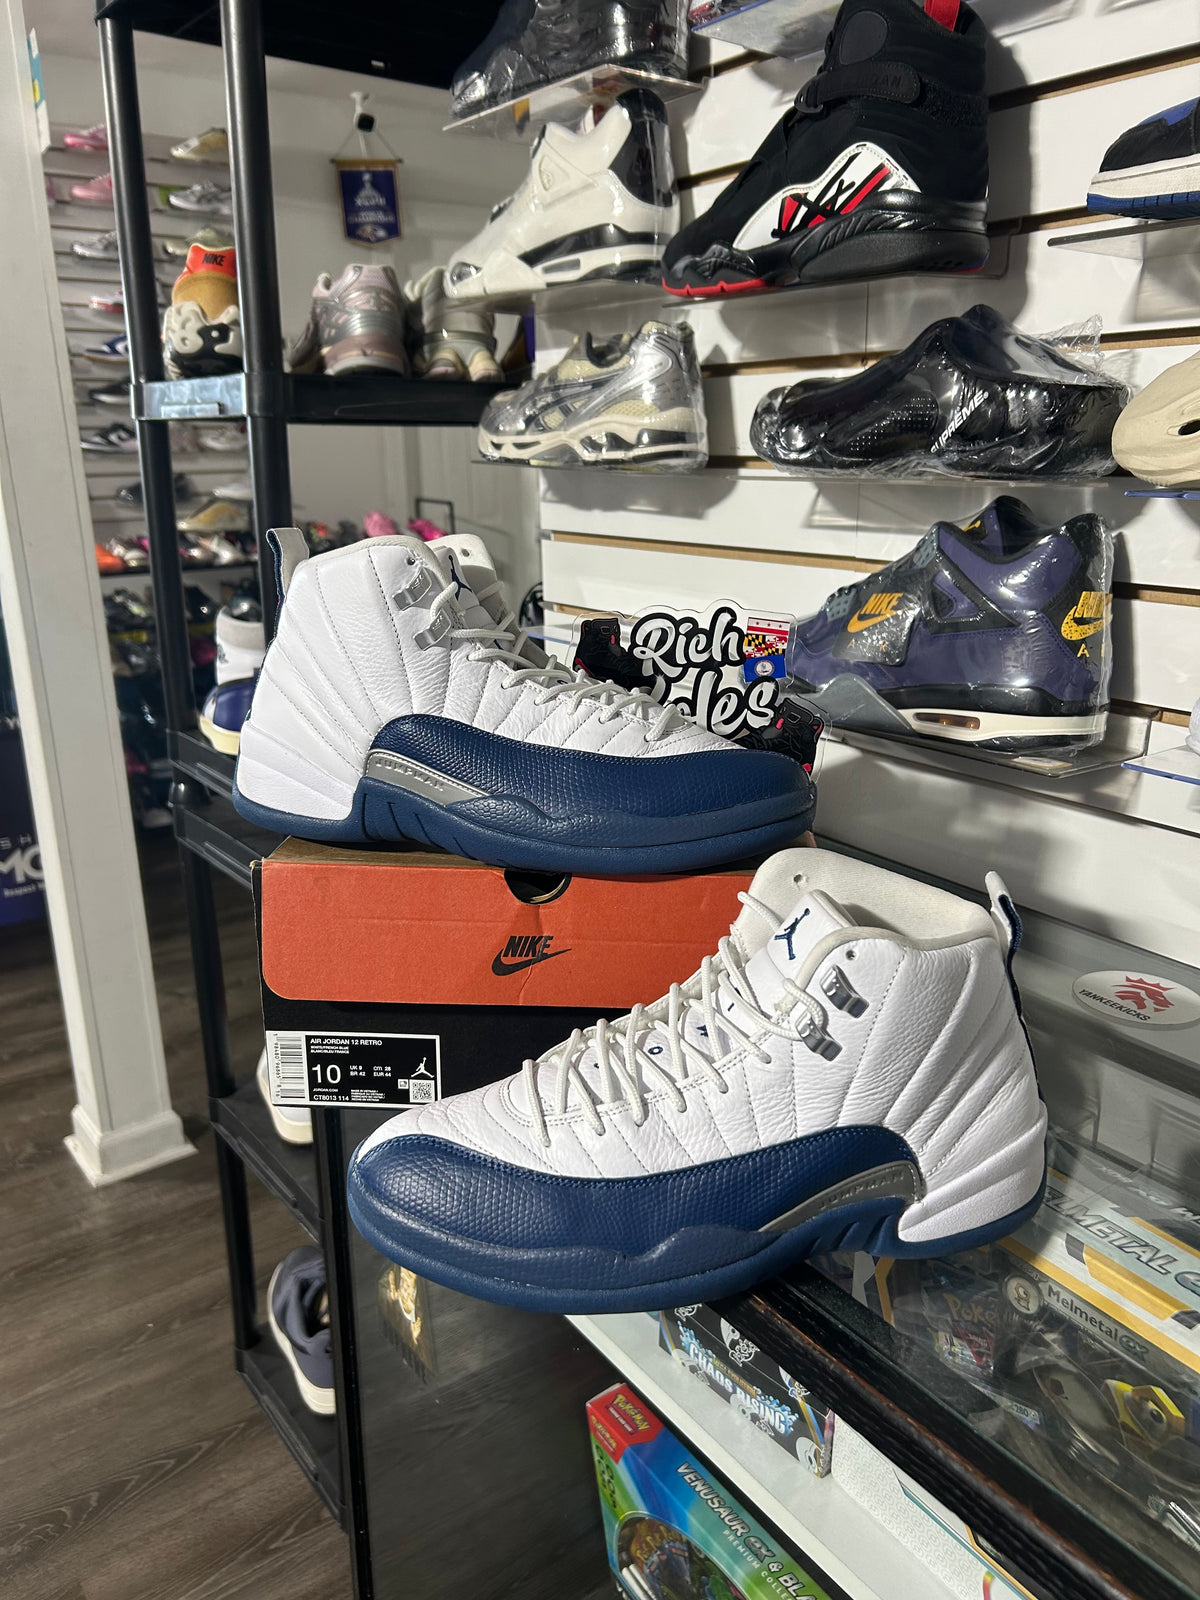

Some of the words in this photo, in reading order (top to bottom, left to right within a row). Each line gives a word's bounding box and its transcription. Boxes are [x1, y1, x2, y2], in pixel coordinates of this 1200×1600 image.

[861, 592, 904, 615] NIKE
[632, 611, 741, 678] Rich
[375, 758, 445, 792] JUMPMAN
[503, 935, 554, 958] NIKE
[1079, 988, 1151, 1021] YANKEEKICKS
[312, 1063, 342, 1084] 10
[1047, 1283, 1119, 1343] Melmetal
[689, 1342, 734, 1393] CHAOS
[677, 1462, 751, 1537] VENUSAUR
[768, 1562, 784, 1573] &
[722, 1529, 761, 1569] PREMIUM
[761, 1571, 794, 1600] COLLE
